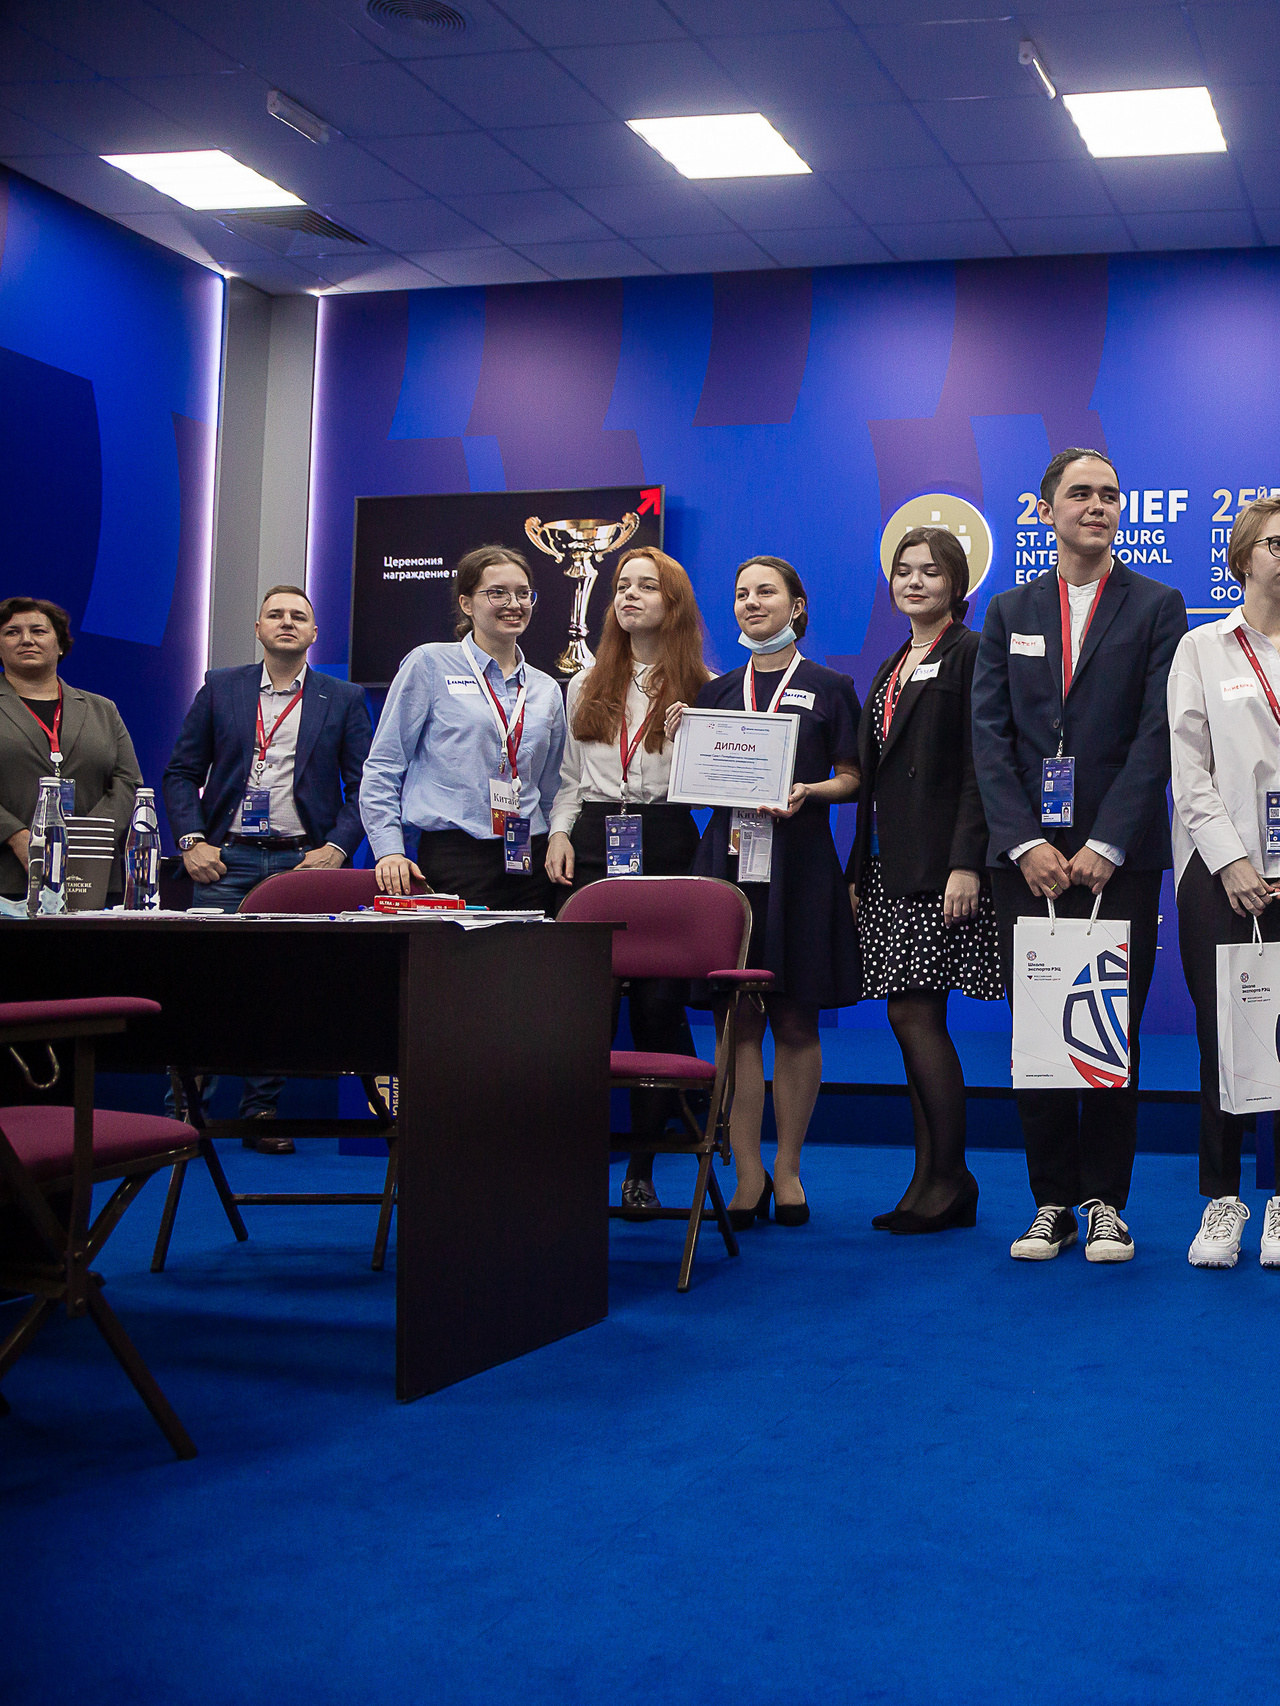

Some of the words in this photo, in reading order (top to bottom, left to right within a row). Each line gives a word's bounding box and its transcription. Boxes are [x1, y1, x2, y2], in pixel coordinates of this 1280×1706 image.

[1016, 532, 1042, 547] ST.
[1050, 529, 1166, 547] PBURG
[383, 556, 443, 568] Церемония
[383, 569, 450, 581] награждение
[714, 742, 756, 752] ДИПЛОМ
